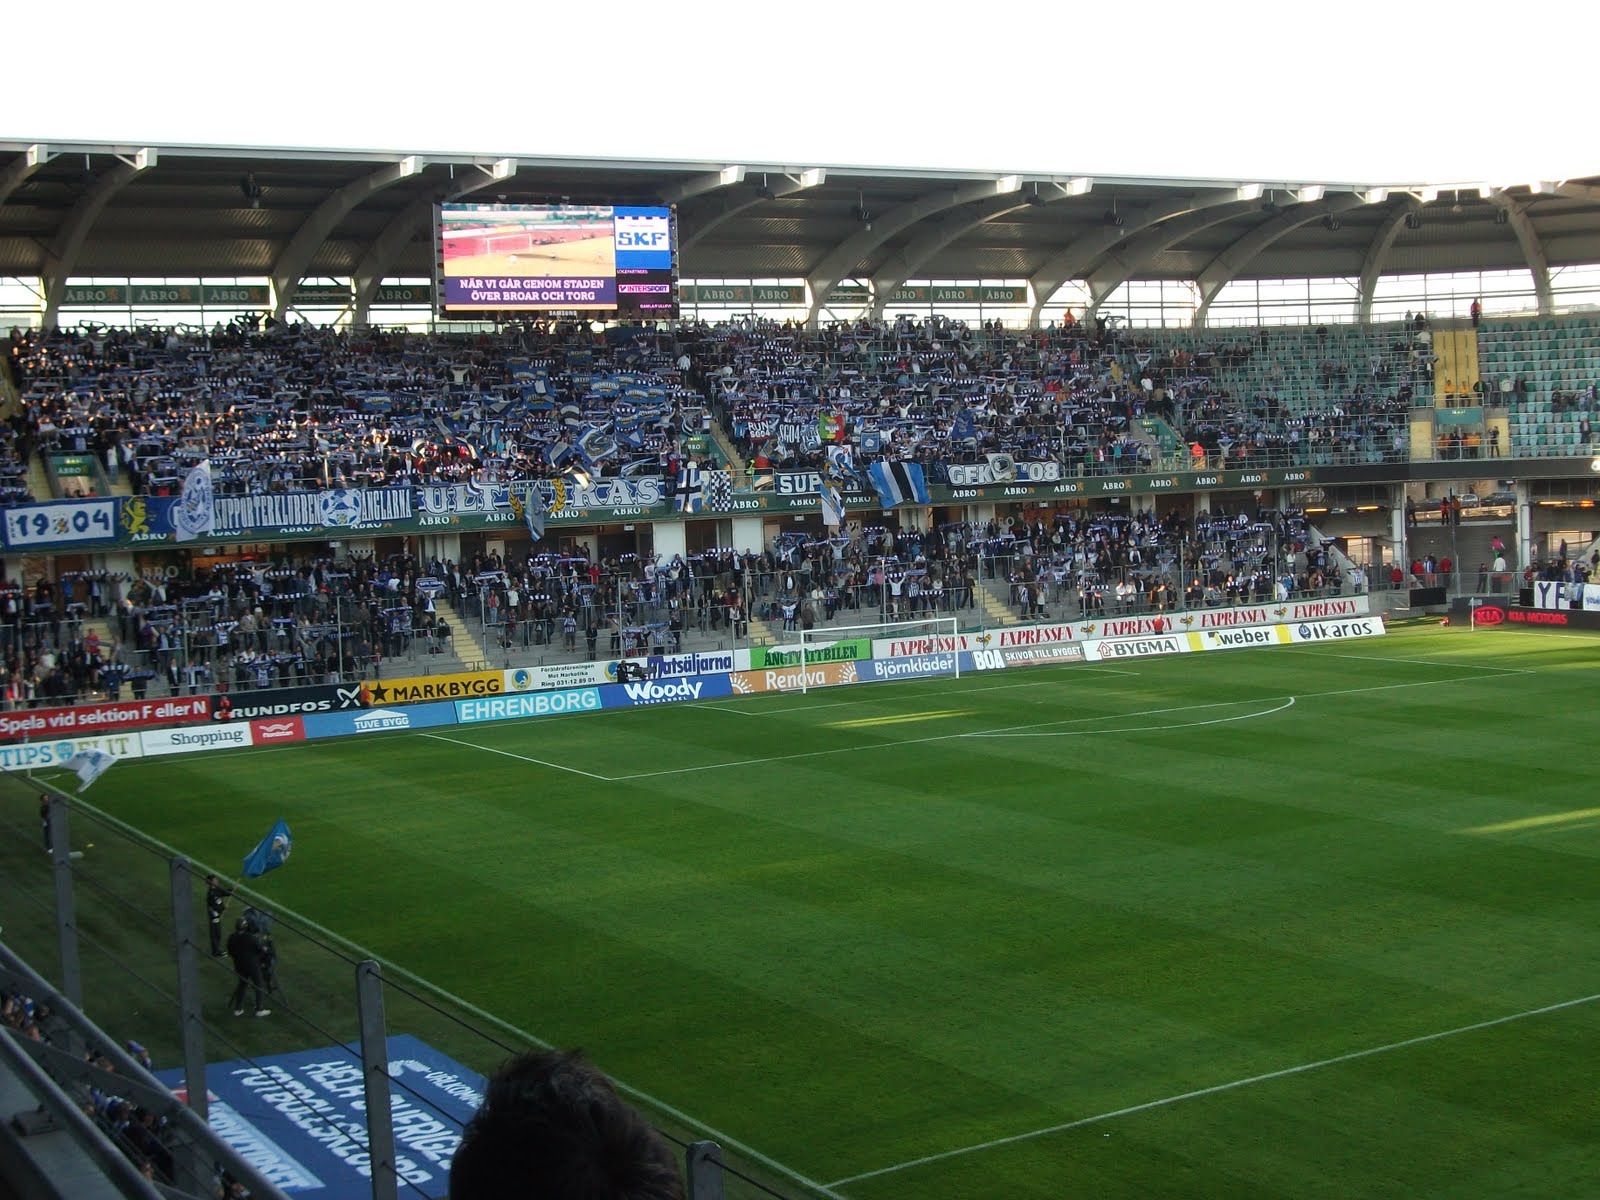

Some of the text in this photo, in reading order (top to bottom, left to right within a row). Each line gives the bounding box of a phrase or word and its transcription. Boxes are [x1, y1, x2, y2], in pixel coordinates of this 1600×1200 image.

[617, 232, 666, 246] SKF
[460, 277, 605, 290] NÄR VI GÅR GENOM STADEN
[471, 289, 595, 301] ÖVER BROAR OCH TORG
[747, 420, 769, 432] RUN
[214, 492, 321, 530] SUPPORTERKLUBBEN
[1201, 608, 1268, 628] EXPRESSEN
[1293, 600, 1357, 619] EXPRESSEN
[1476, 611, 1501, 621] KIA
[1508, 611, 1568, 624] KIA MOTORS
[1000, 626, 1074, 647] EXPRESSEN
[1103, 617, 1173, 637] EXPRESSN
[1219, 629, 1270, 646] weber
[1114, 640, 1177, 656] BYGMA
[874, 656, 953, 678] Björnkläder
[973, 646, 1081, 670] BOA SKIVOR TILL BYGGET
[393, 678, 499, 701] MARKBYGG
[623, 677, 703, 700] Woody
[765, 671, 826, 690] Renova
[461, 690, 597, 721] EHRENBORG
[0, 701, 207, 734] Spela vid sektion F eller N
[355, 716, 409, 729] TUVE BYGG
[171, 729, 244, 746] Shopping
[0, 745, 53, 766] TIPS
